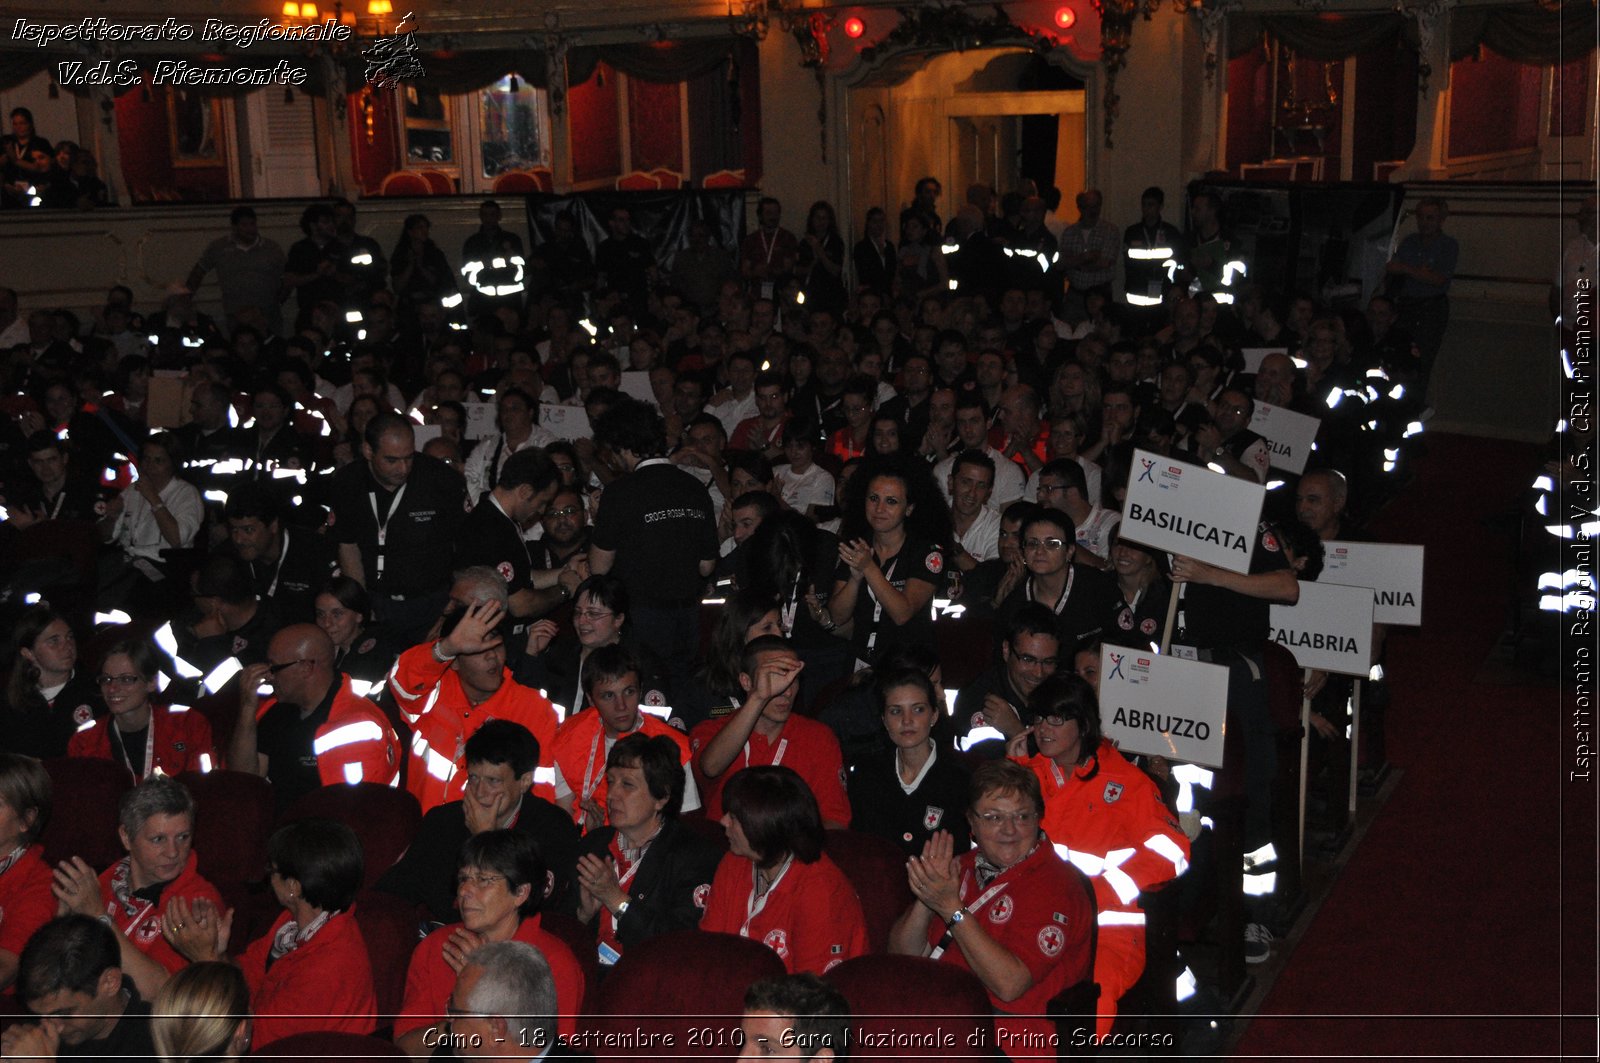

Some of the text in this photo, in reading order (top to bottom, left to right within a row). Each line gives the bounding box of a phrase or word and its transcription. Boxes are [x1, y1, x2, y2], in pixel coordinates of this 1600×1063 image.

[1265, 440, 1292, 458] GLIA
[644, 510, 667, 523] CROCE
[1128, 503, 1249, 554] BASILICATA
[1112, 706, 1211, 741] ABRUZZO
